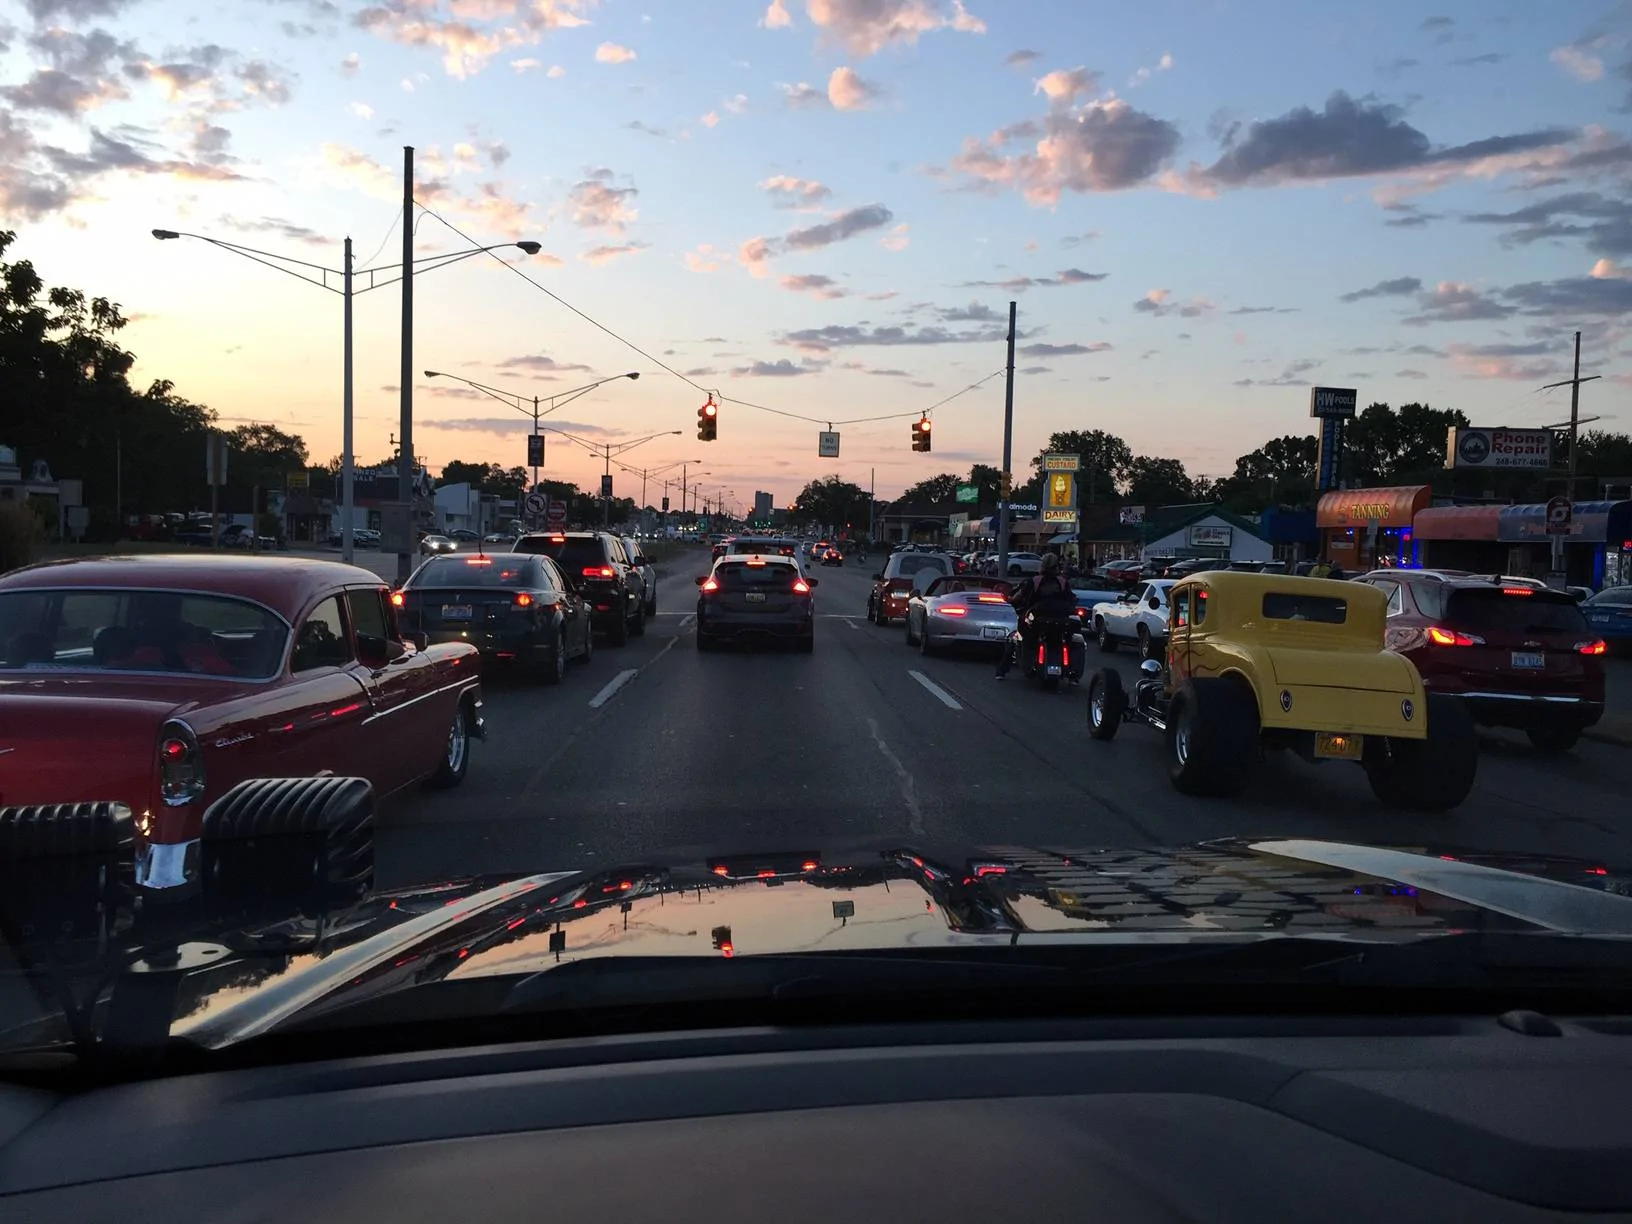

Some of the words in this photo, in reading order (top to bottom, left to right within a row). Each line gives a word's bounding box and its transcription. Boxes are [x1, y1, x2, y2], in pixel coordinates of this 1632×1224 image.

[1492, 432, 1546, 444] Phone
[1491, 443, 1548, 456] Repair
[1047, 461, 1076, 469] CUSTARD
[1045, 511, 1074, 520] DAIRY
[1351, 503, 1389, 519] TANNING
